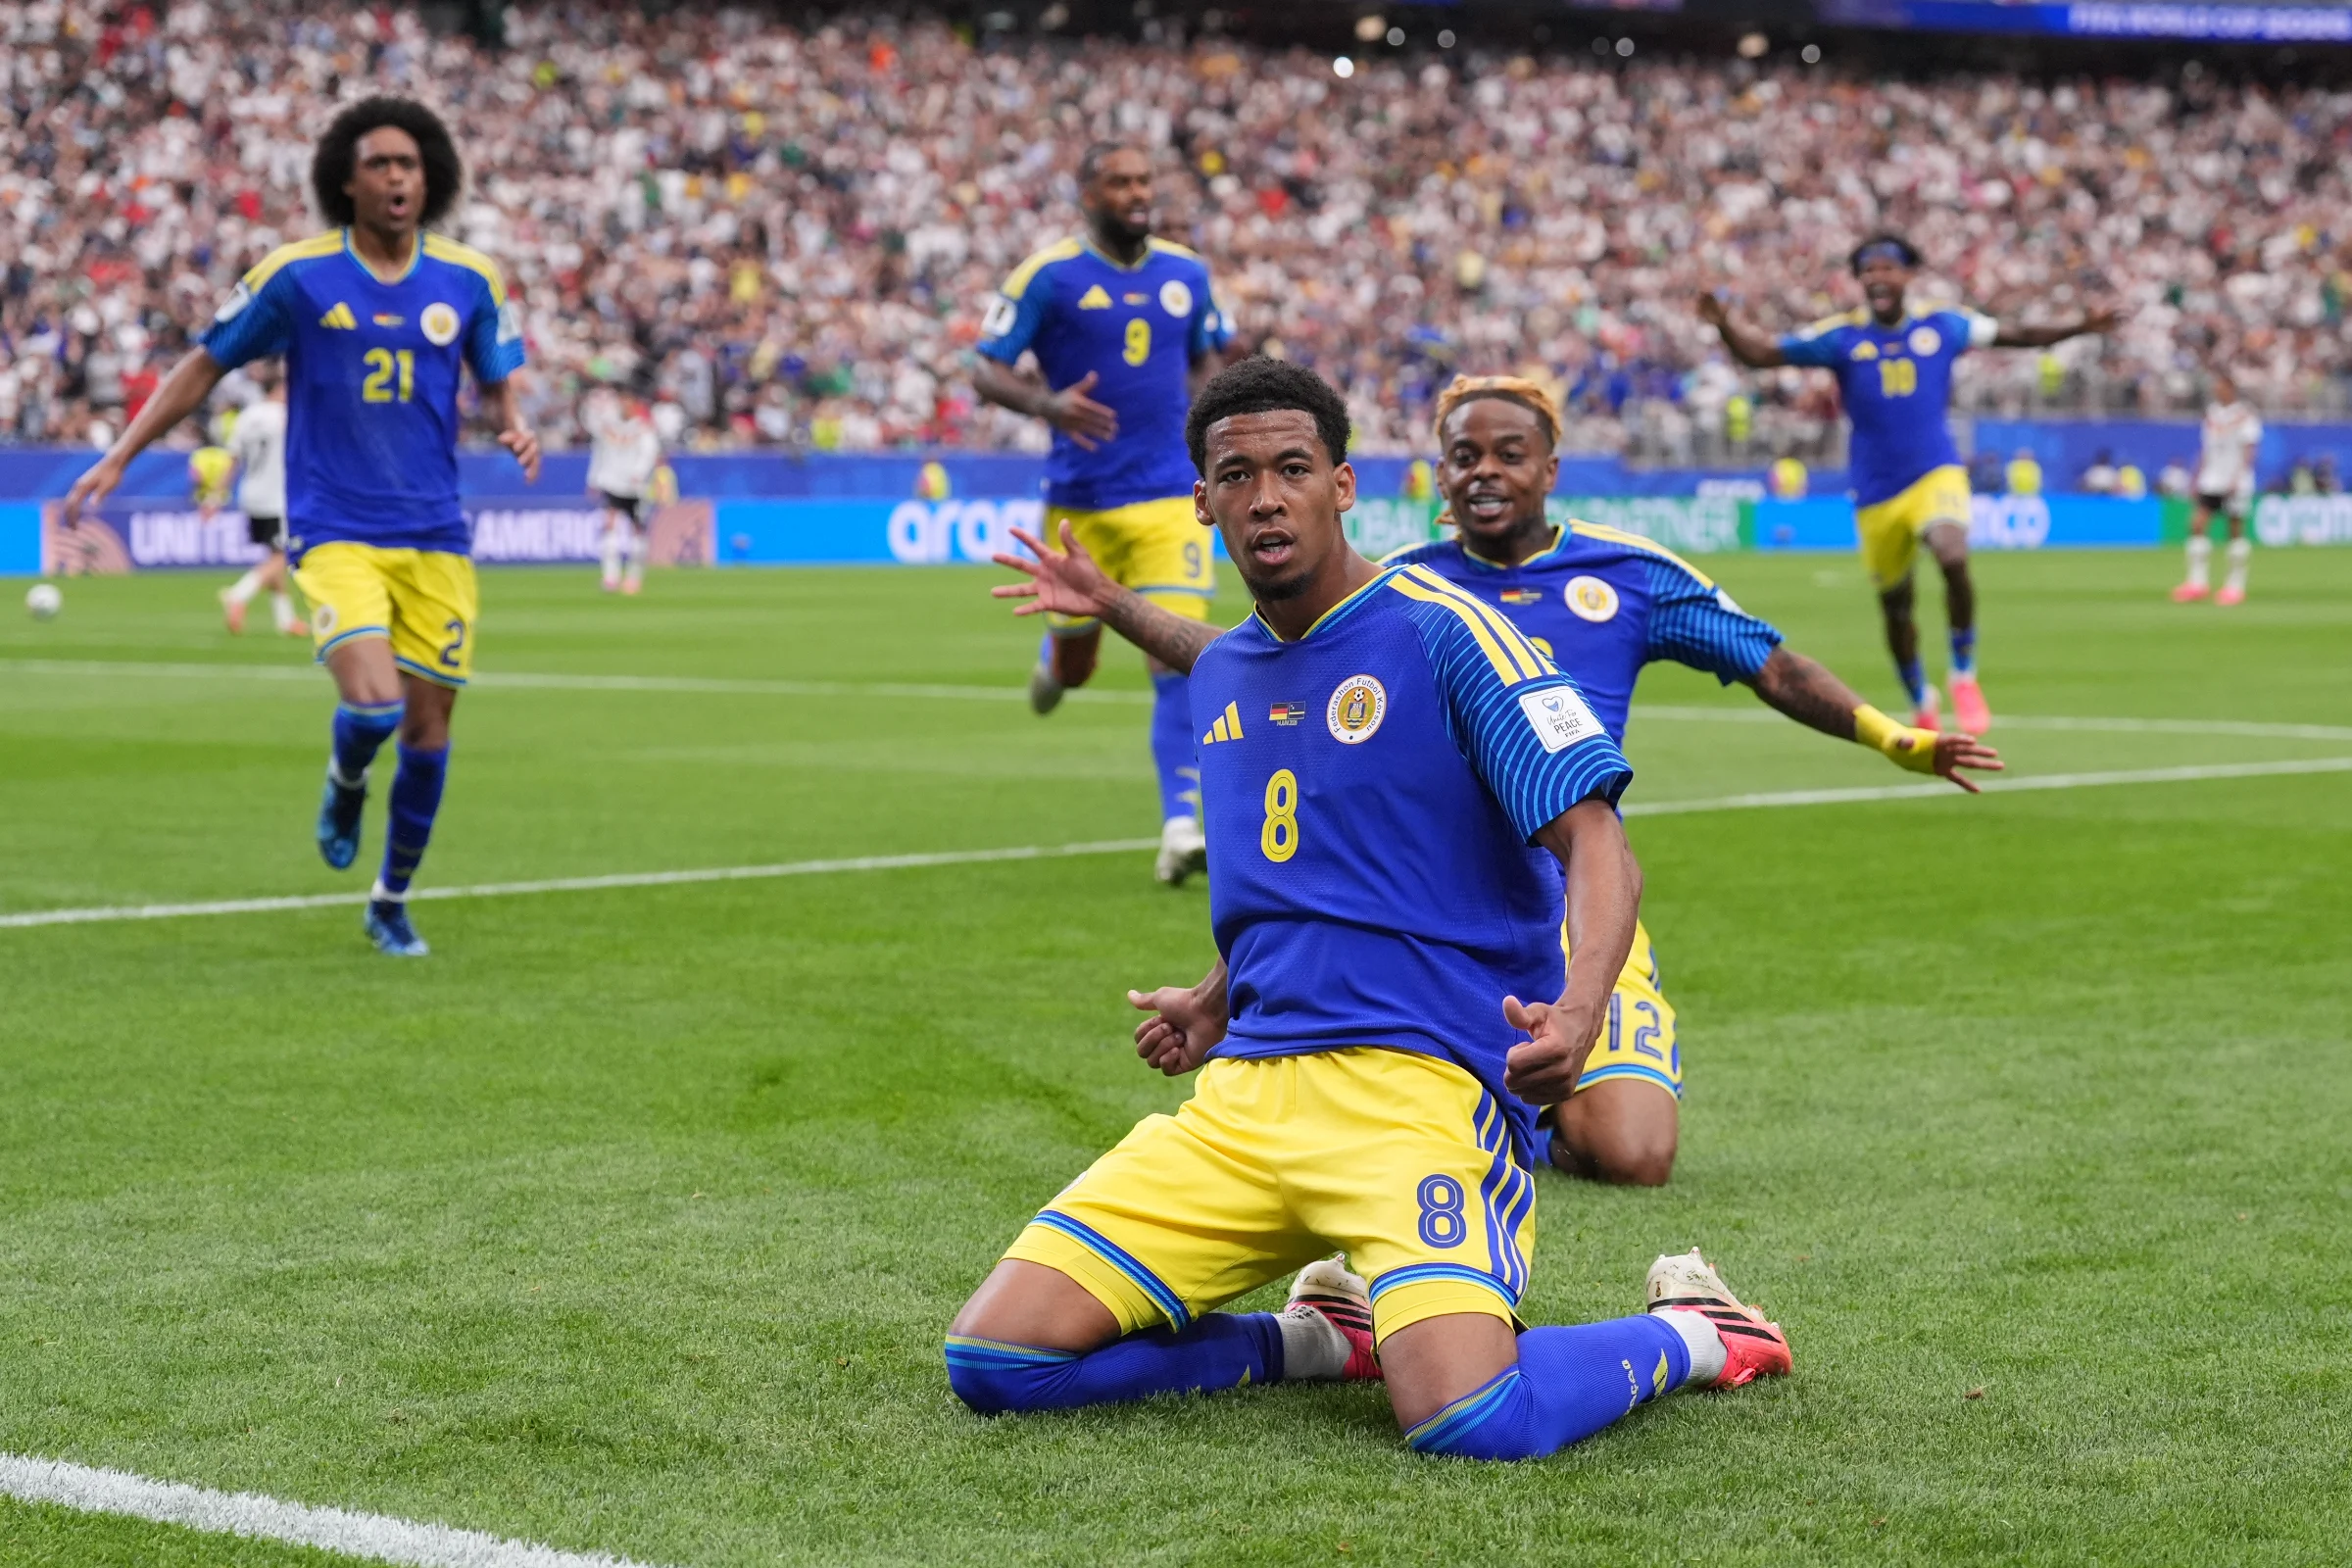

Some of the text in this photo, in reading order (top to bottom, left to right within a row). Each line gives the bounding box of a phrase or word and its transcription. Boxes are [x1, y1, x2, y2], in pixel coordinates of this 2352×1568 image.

[1122, 318, 1152, 367] 9
[363, 347, 415, 403] 21
[1879, 358, 1917, 398] 10
[1184, 542, 1201, 578] 9
[1553, 717, 1583, 734] PEACE
[1564, 729, 1580, 738] FIFA
[1260, 768, 1298, 862] 8
[1609, 993, 1663, 1061] 12
[1416, 1173, 1467, 1249] 8
